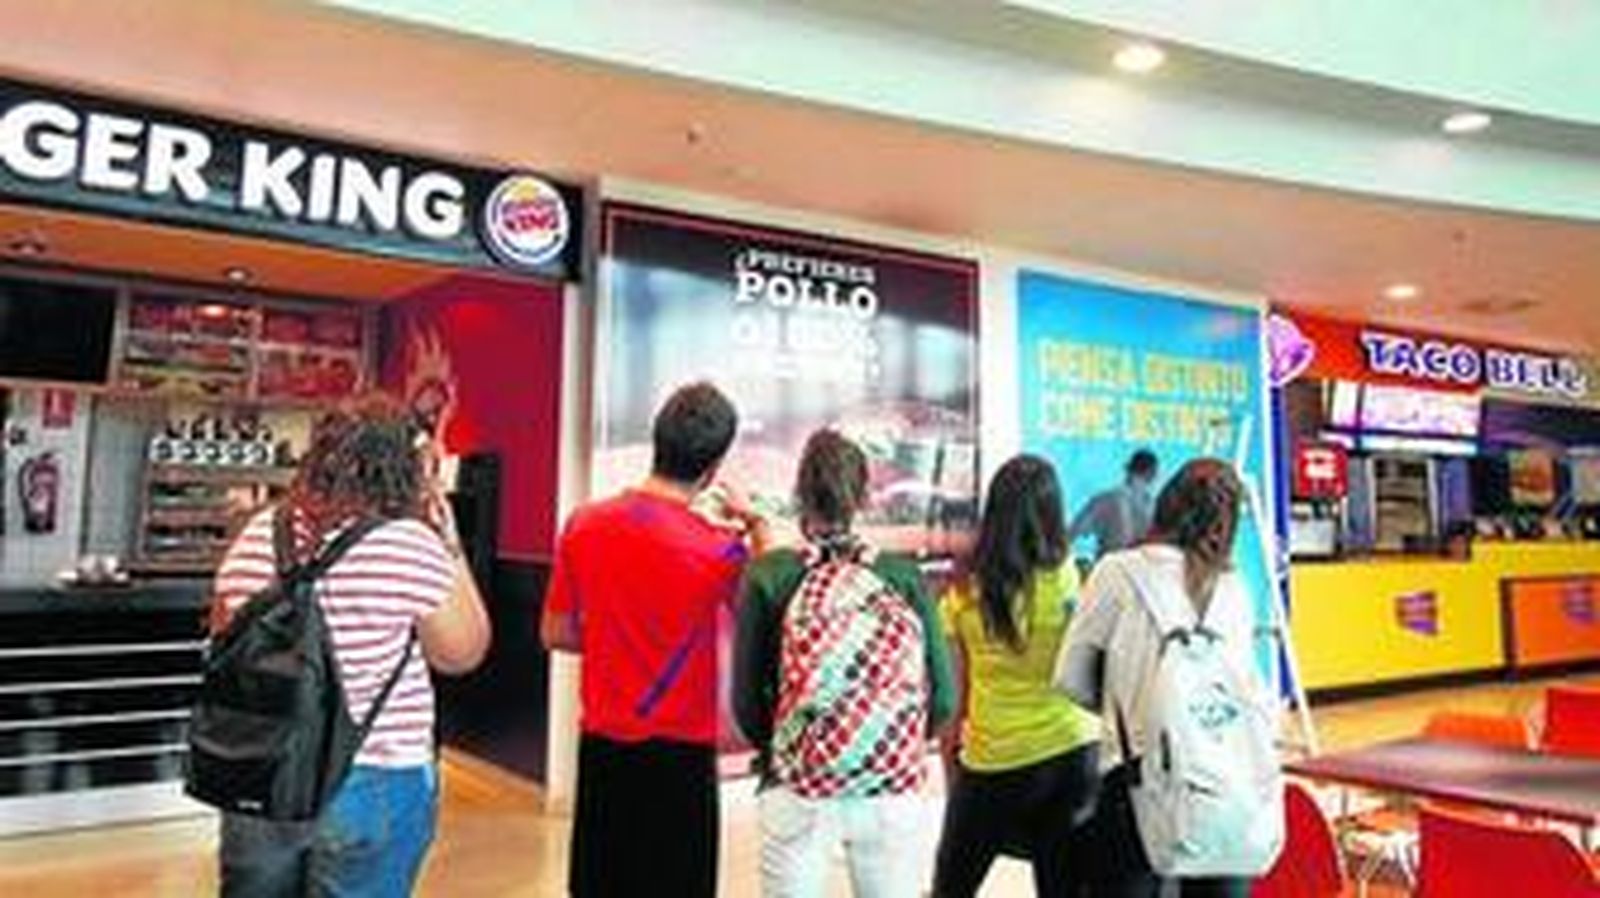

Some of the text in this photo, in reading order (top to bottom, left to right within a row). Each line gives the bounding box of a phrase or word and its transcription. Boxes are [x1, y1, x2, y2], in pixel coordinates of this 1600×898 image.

[0, 101, 464, 239] GER KING
[736, 270, 877, 320] POLLO
[1361, 331, 1587, 397] TACO BELL
